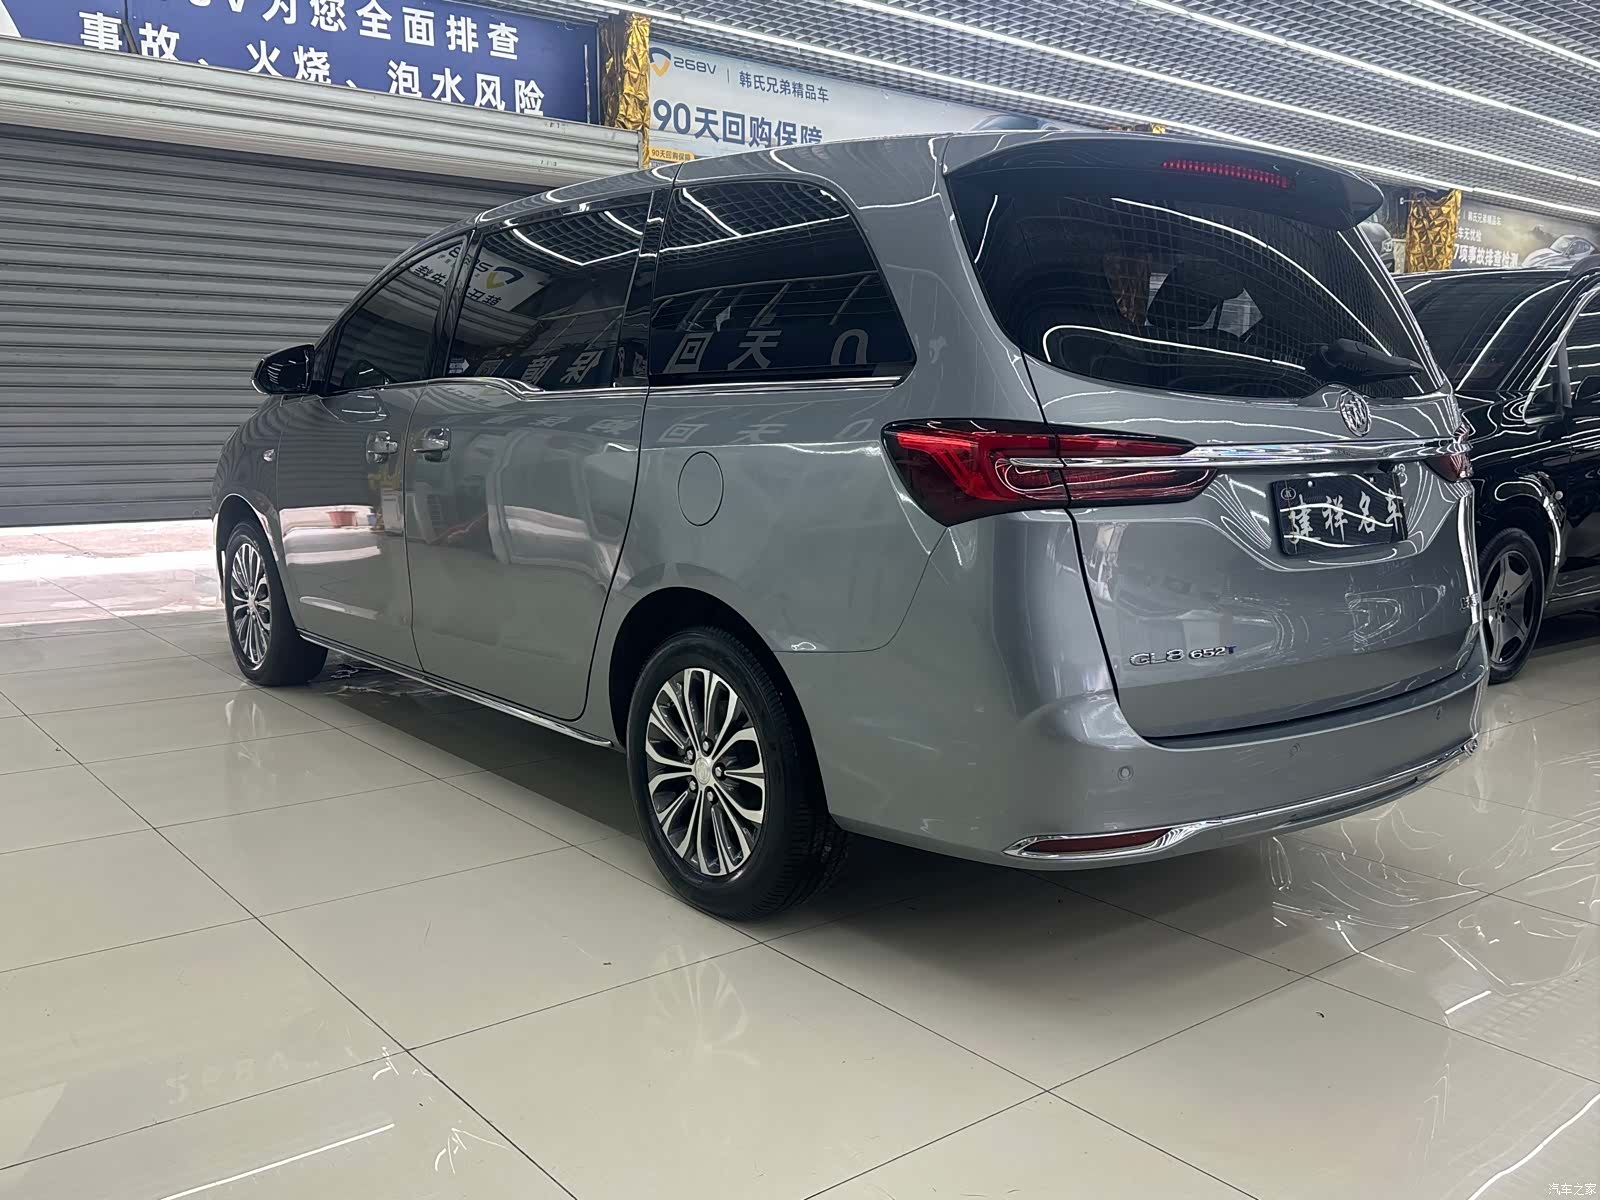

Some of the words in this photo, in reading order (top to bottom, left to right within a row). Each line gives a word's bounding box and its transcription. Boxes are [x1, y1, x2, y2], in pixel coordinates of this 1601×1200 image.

[188, 0, 519, 60] 为您全面排查
[674, 57, 716, 75] 268V
[739, 71, 829, 103] 韩氏兄弟精品车
[653, 99, 822, 148] 90天回购保障
[1130, 649, 1185, 666] GL8
[1188, 646, 1236, 660] 652T
